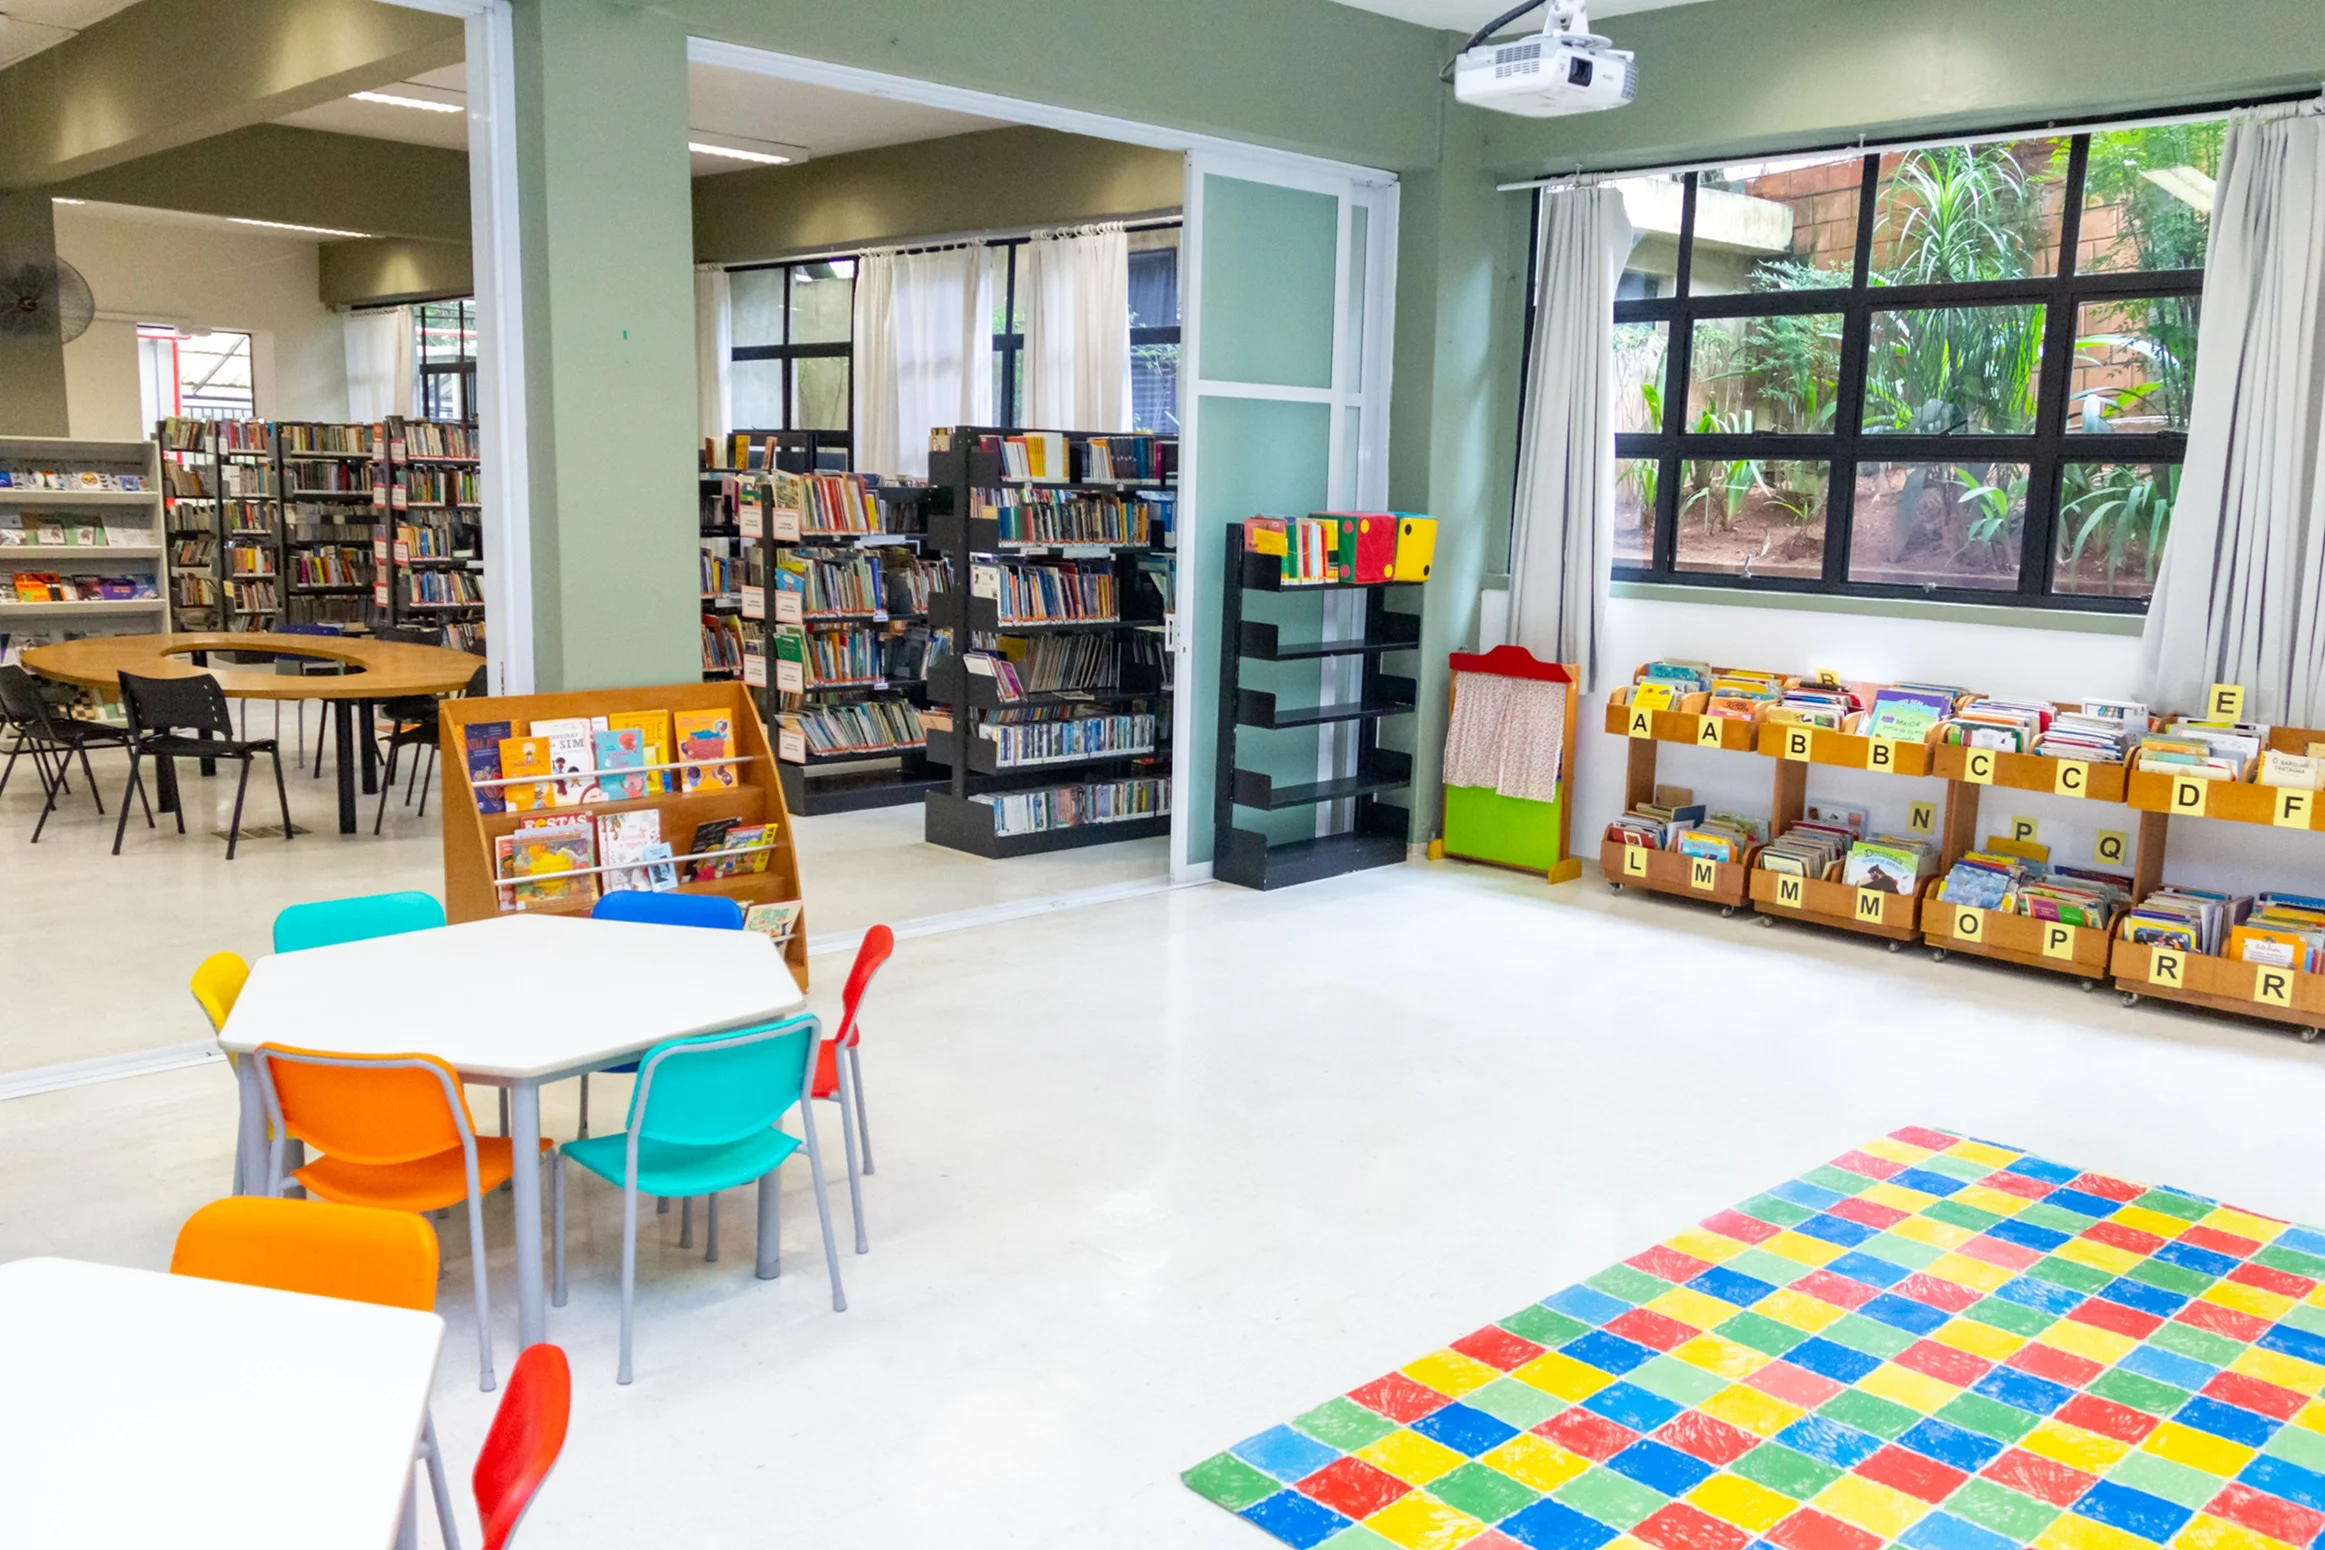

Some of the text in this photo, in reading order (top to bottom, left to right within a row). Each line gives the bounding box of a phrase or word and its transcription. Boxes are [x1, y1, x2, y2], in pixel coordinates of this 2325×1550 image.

[2215, 691, 2237, 714] E
[1632, 713, 1648, 732] A
[1701, 722, 1718, 741] A
[559, 738, 585, 750] SIM
[1790, 734, 1806, 754] B
[1872, 744, 1889, 765] B
[1971, 755, 1989, 777] C
[2062, 767, 2082, 789] C
[2178, 783, 2200, 807] D
[1912, 807, 1931, 829] N
[2283, 795, 2304, 819] F
[2015, 822, 2033, 841] P
[2099, 836, 2121, 861] Q
[1630, 851, 1642, 871] L
[1695, 863, 1712, 884] M
[1780, 879, 1799, 901] M
[1860, 894, 1880, 917] M
[1958, 913, 1979, 935] O
[2050, 928, 2068, 949] P
[2156, 955, 2178, 980] R
[2262, 973, 2285, 999] R
